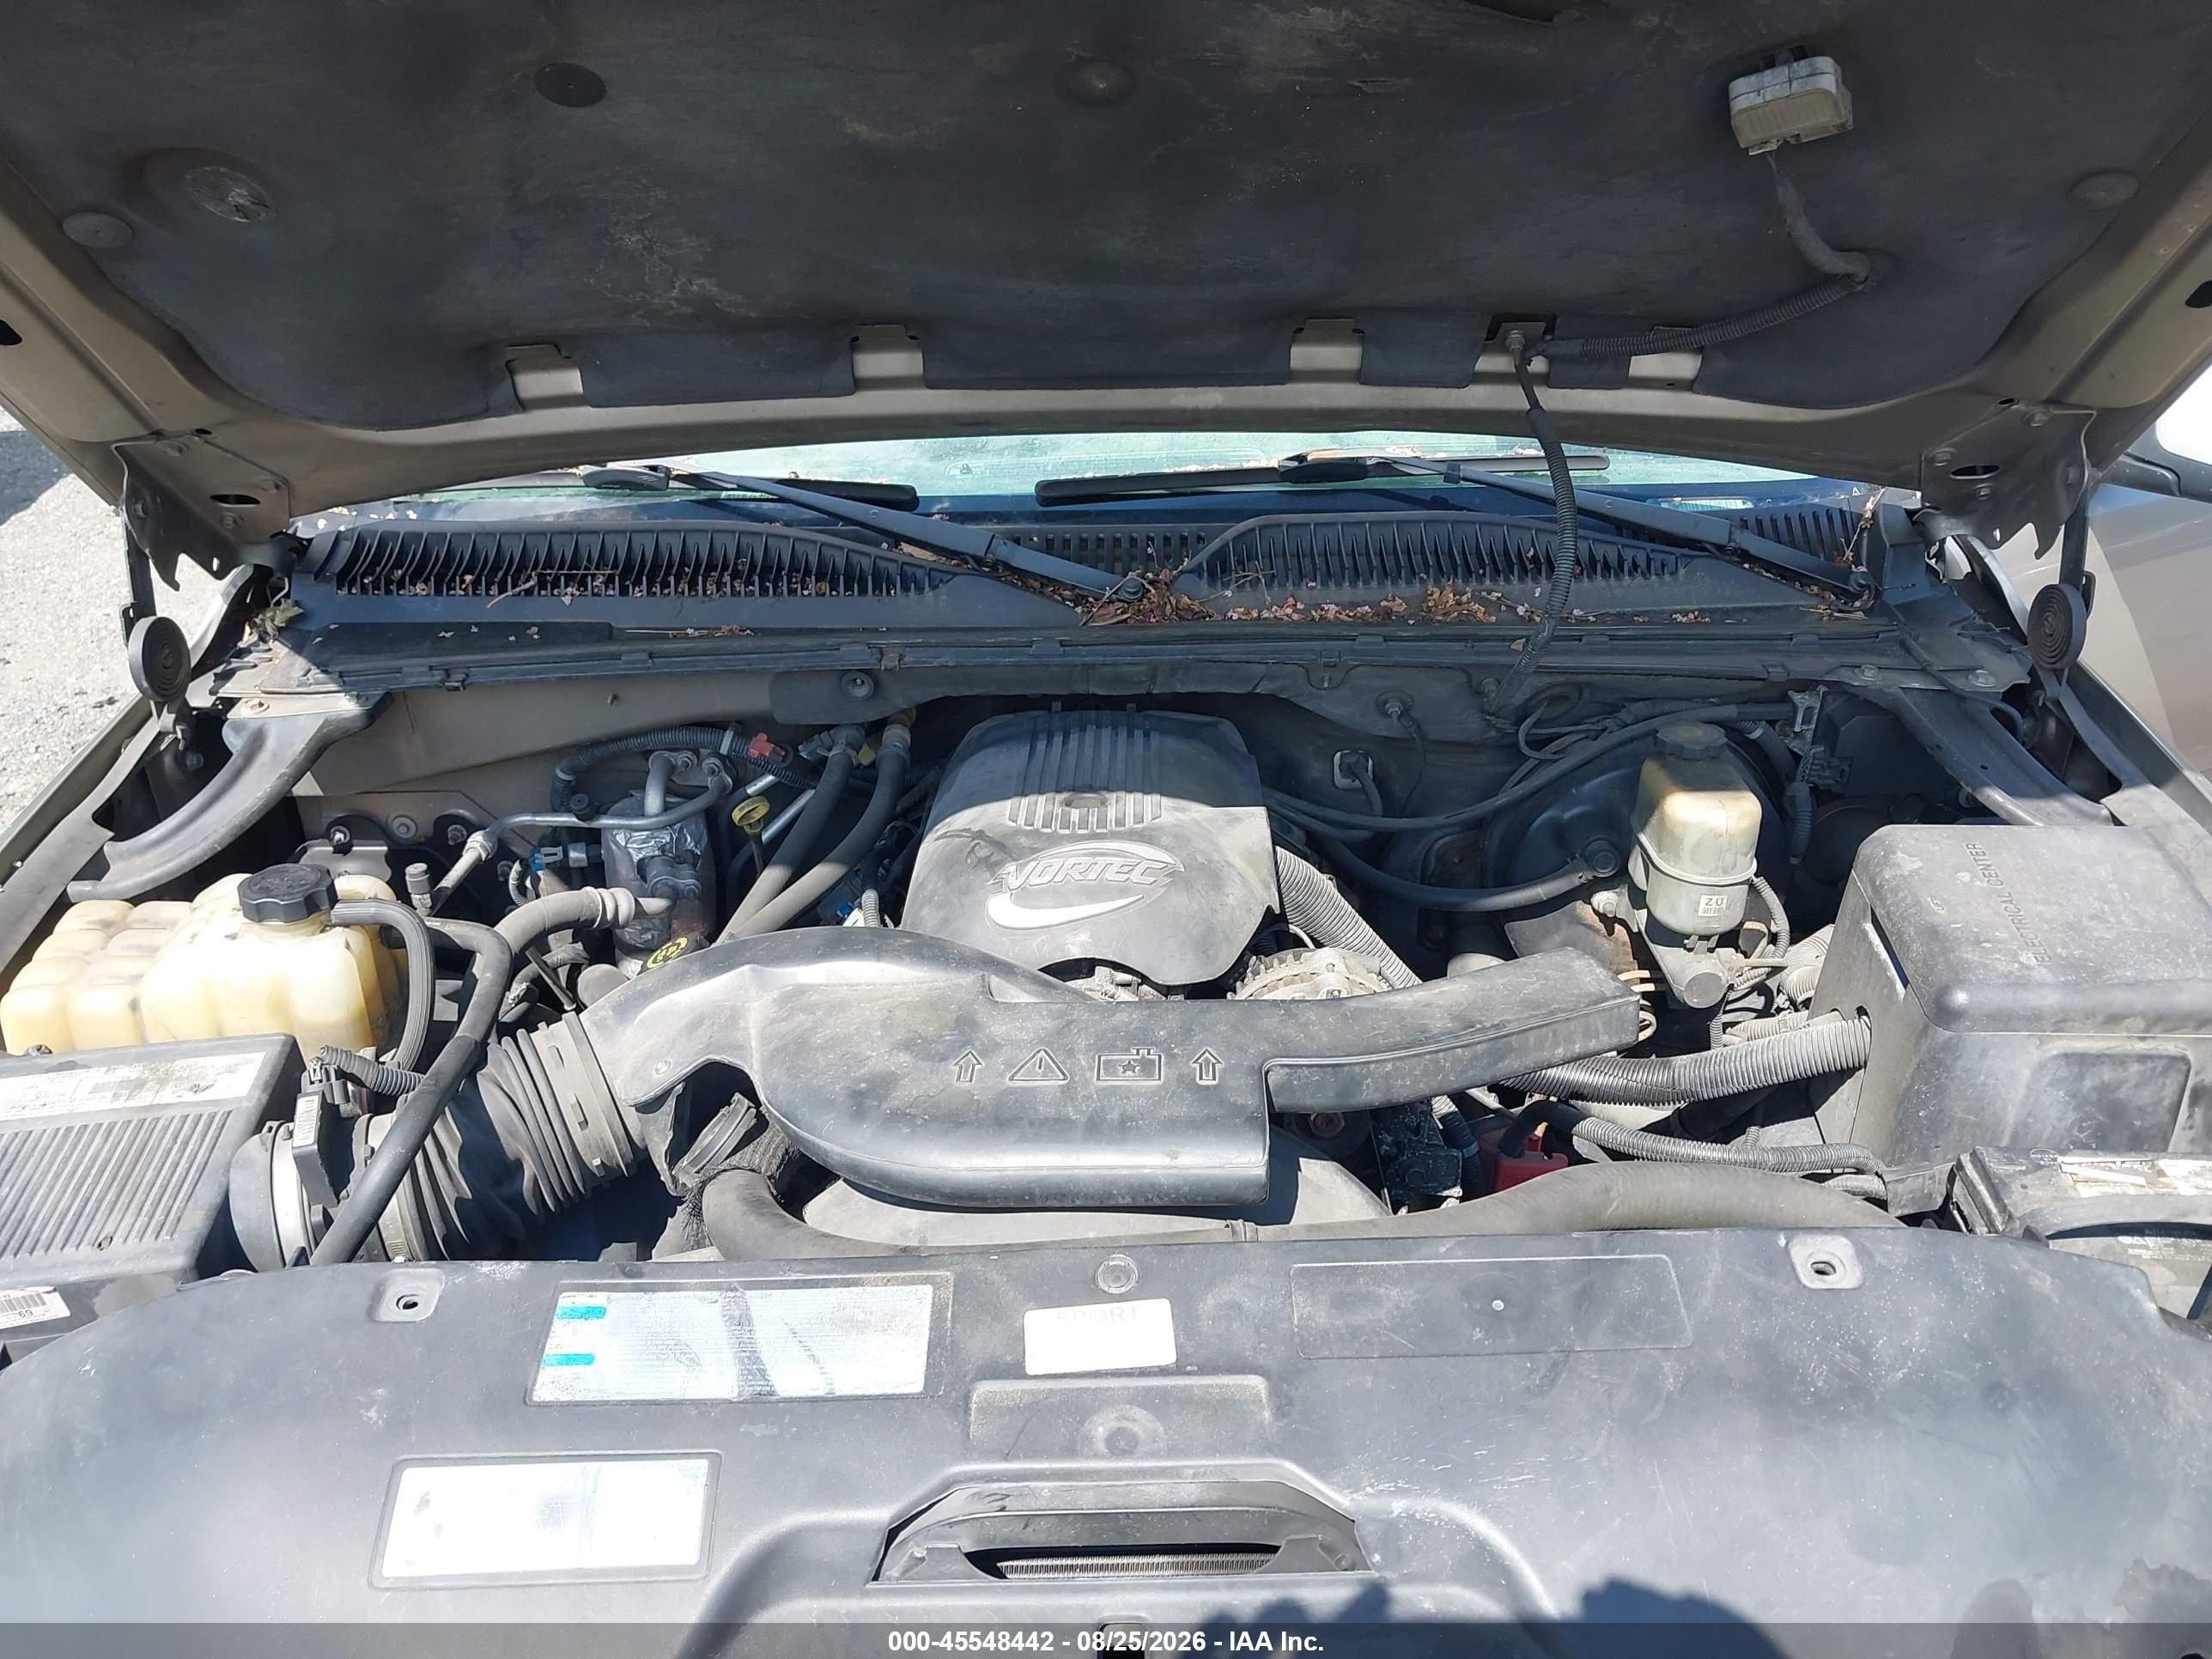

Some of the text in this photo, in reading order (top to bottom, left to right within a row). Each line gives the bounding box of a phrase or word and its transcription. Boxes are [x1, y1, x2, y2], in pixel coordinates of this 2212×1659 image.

[999, 856, 1170, 890] VORTEC
[1966, 842, 2052, 963] ELECTRICAL CENTER
